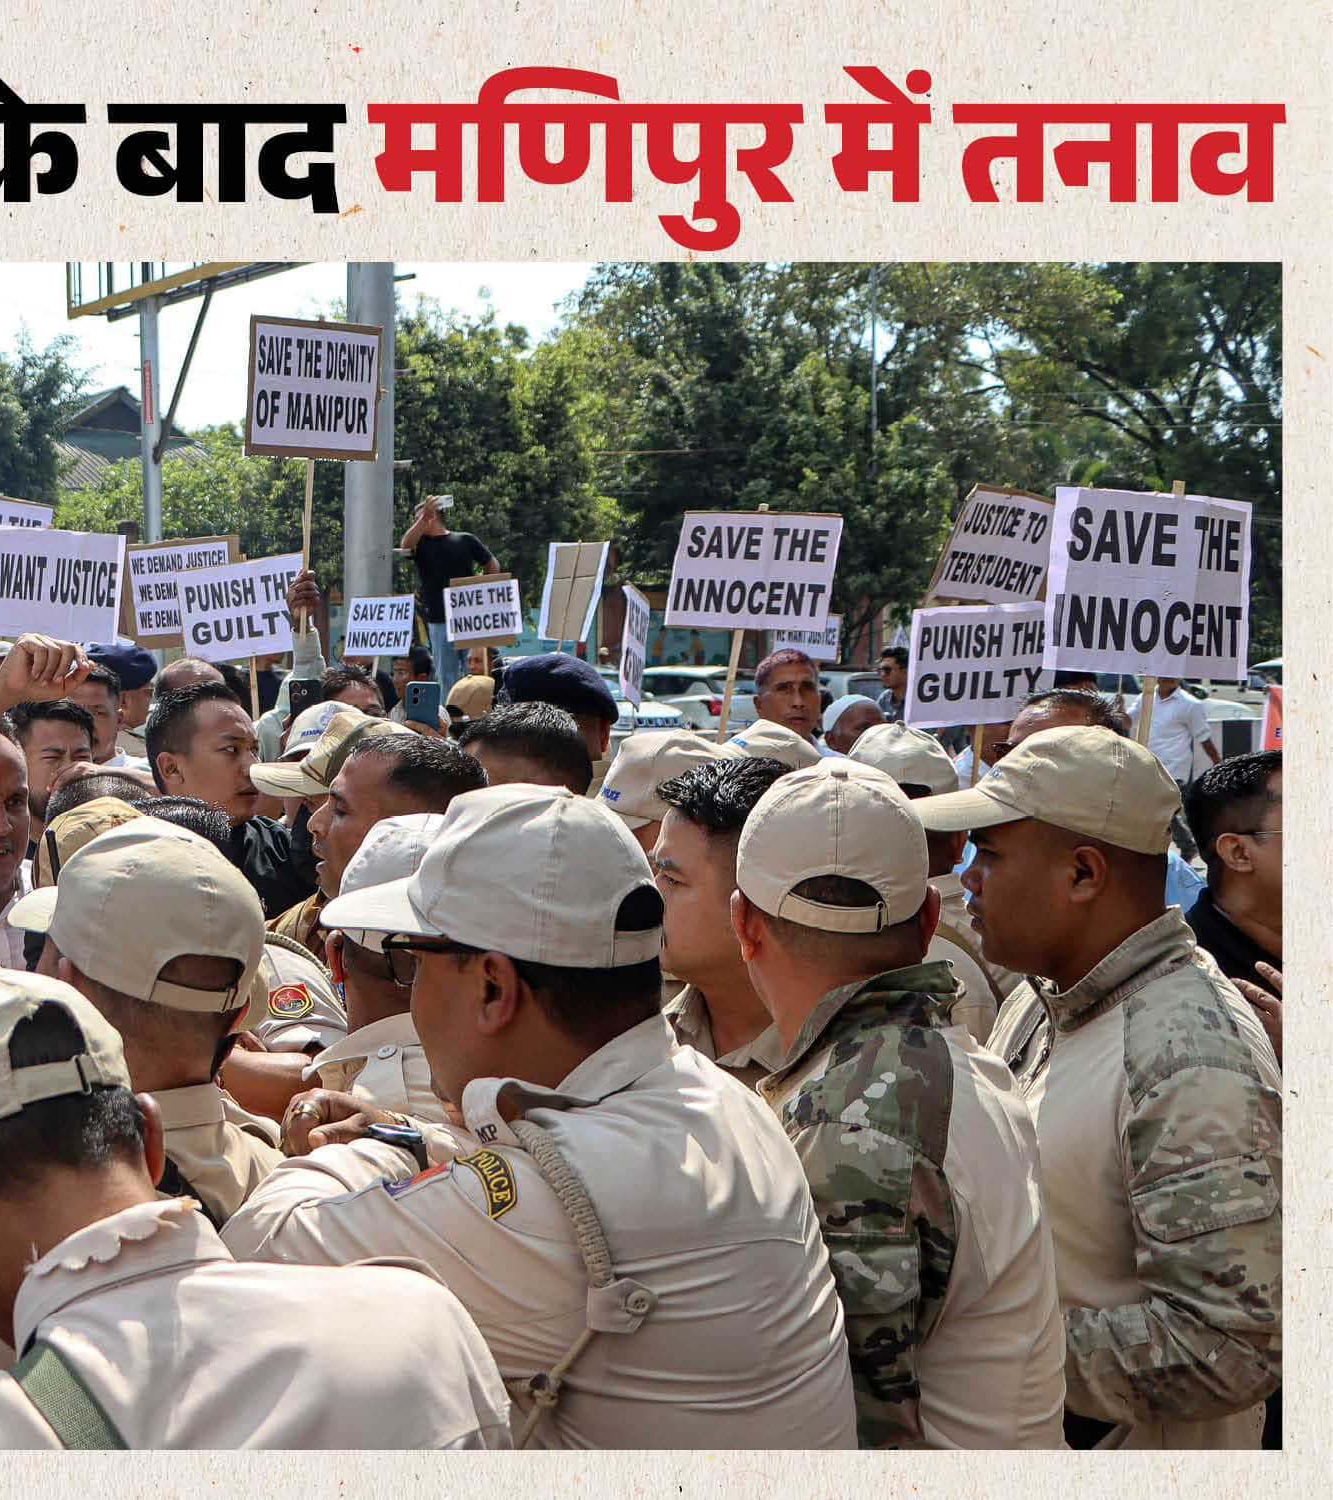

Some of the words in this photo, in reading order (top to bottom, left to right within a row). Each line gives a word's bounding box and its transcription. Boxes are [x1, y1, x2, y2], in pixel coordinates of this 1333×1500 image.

[258, 334, 292, 376] SAVE
[296, 338, 322, 379] THE
[325, 341, 375, 384] DIGNITY
[256, 389, 281, 428] OF
[286, 392, 368, 434] MANIPUR
[963, 503, 1025, 539] JUSTICE
[1022, 512, 1048, 544] TO
[1067, 506, 1179, 567] SAVE
[1194, 515, 1241, 573] THE
[131, 557, 146, 576] WE
[148, 553, 183, 574] DEMAND
[185, 549, 226, 569] JUSTICE!
[687, 525, 763, 560] SAVE
[772, 528, 830, 563] THE
[0, 552, 47, 601] WANT
[50, 557, 119, 608] JUSTICE
[139, 584, 154, 602] WE
[154, 582, 178, 601] DEMA
[184, 577, 256, 613] PUNISH
[260, 571, 297, 602] THE
[944, 551, 1043, 595] TER/STUDENT
[352, 603, 385, 621] SAVE
[389, 602, 410, 620] THE
[450, 589, 484, 608] SAVE
[487, 586, 514, 604] THE
[672, 578, 827, 617] INNOCENT
[139, 611, 154, 629] WE
[347, 630, 410, 648] INNOCENT
[450, 611, 519, 634] INNOCENT
[1052, 593, 1243, 658] INNOCENT
[918, 624, 1004, 661] PUNISH
[1012, 620, 1045, 656] THE
[917, 666, 1043, 703] GUILTY
[474, 1123, 498, 1144] MP
[470, 1152, 512, 1203] POLICE
